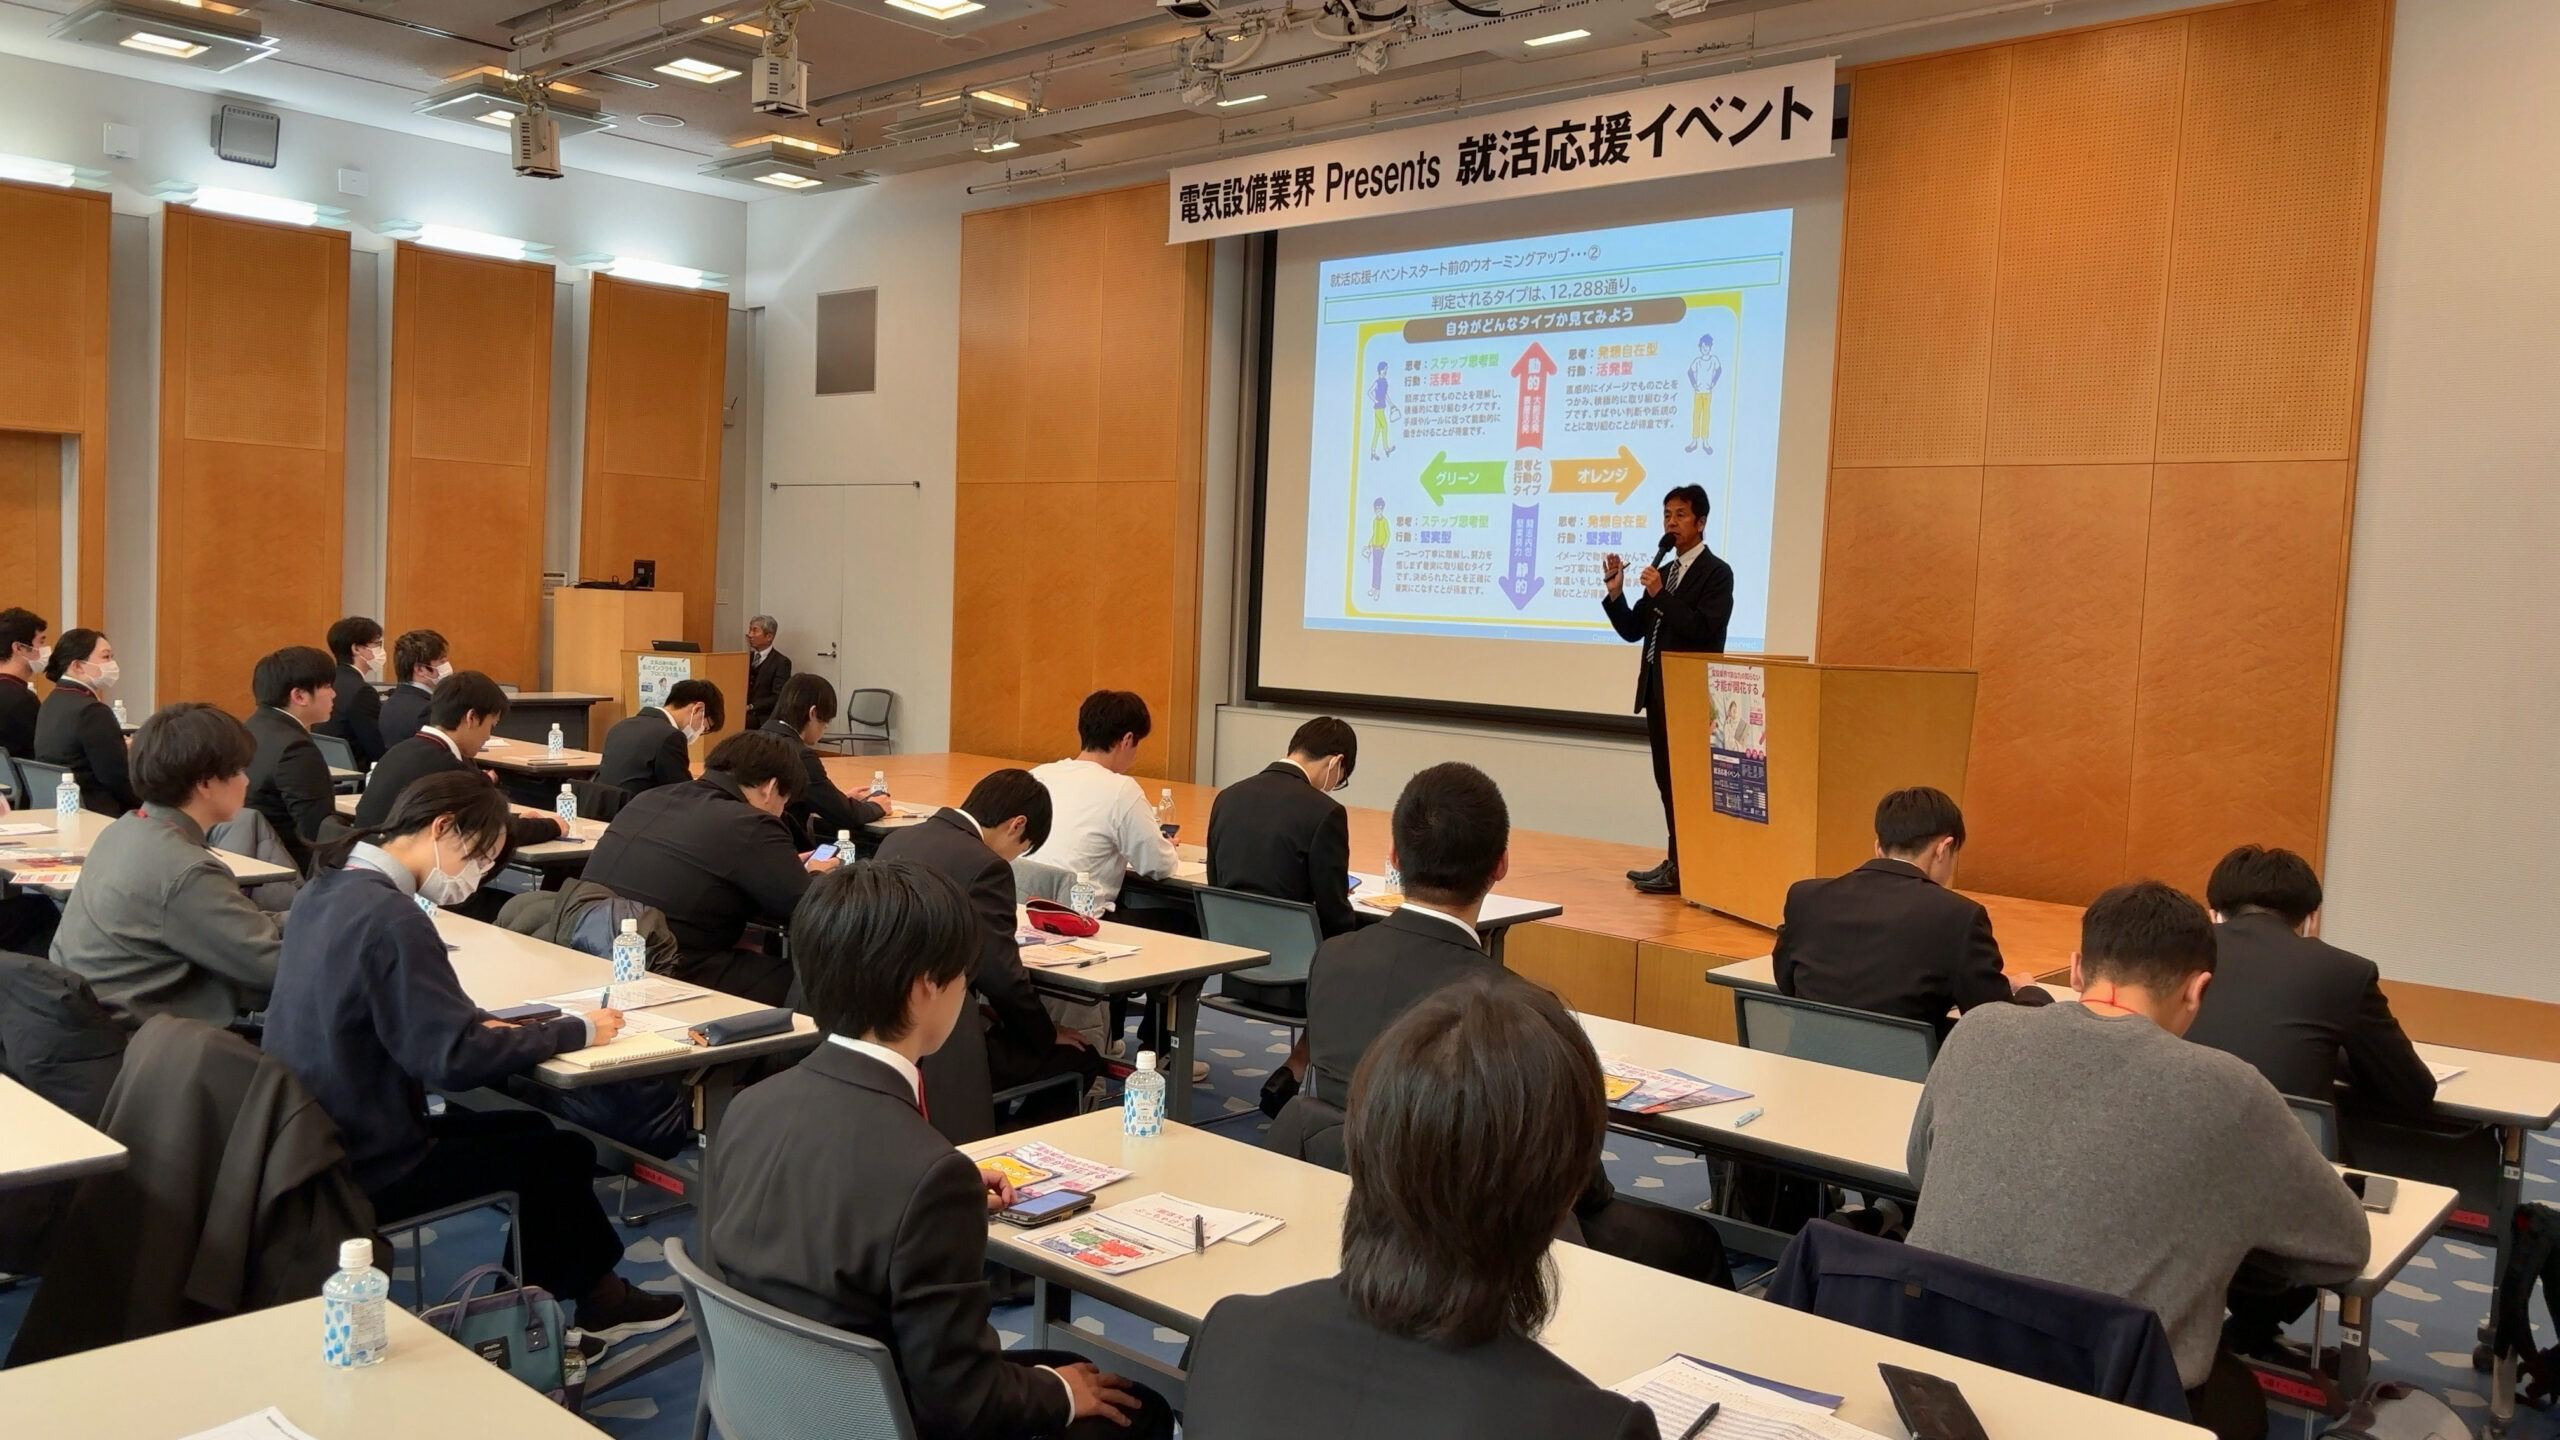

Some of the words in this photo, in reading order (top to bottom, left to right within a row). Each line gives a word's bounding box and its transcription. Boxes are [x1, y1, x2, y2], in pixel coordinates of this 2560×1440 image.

[1179, 165, 1315, 223] 電気設備業界
[1326, 151, 1440, 203] Presents
[1456, 85, 1814, 187] 就活応援イベント
[1445, 306, 1634, 337] 自分がどんなタイプか見てみよう
[1435, 471, 1480, 486] グリーン
[1577, 467, 1629, 484] オレンジ
[1512, 484, 1541, 496] タイプ
[1713, 679, 1759, 695] 才能が開花する
